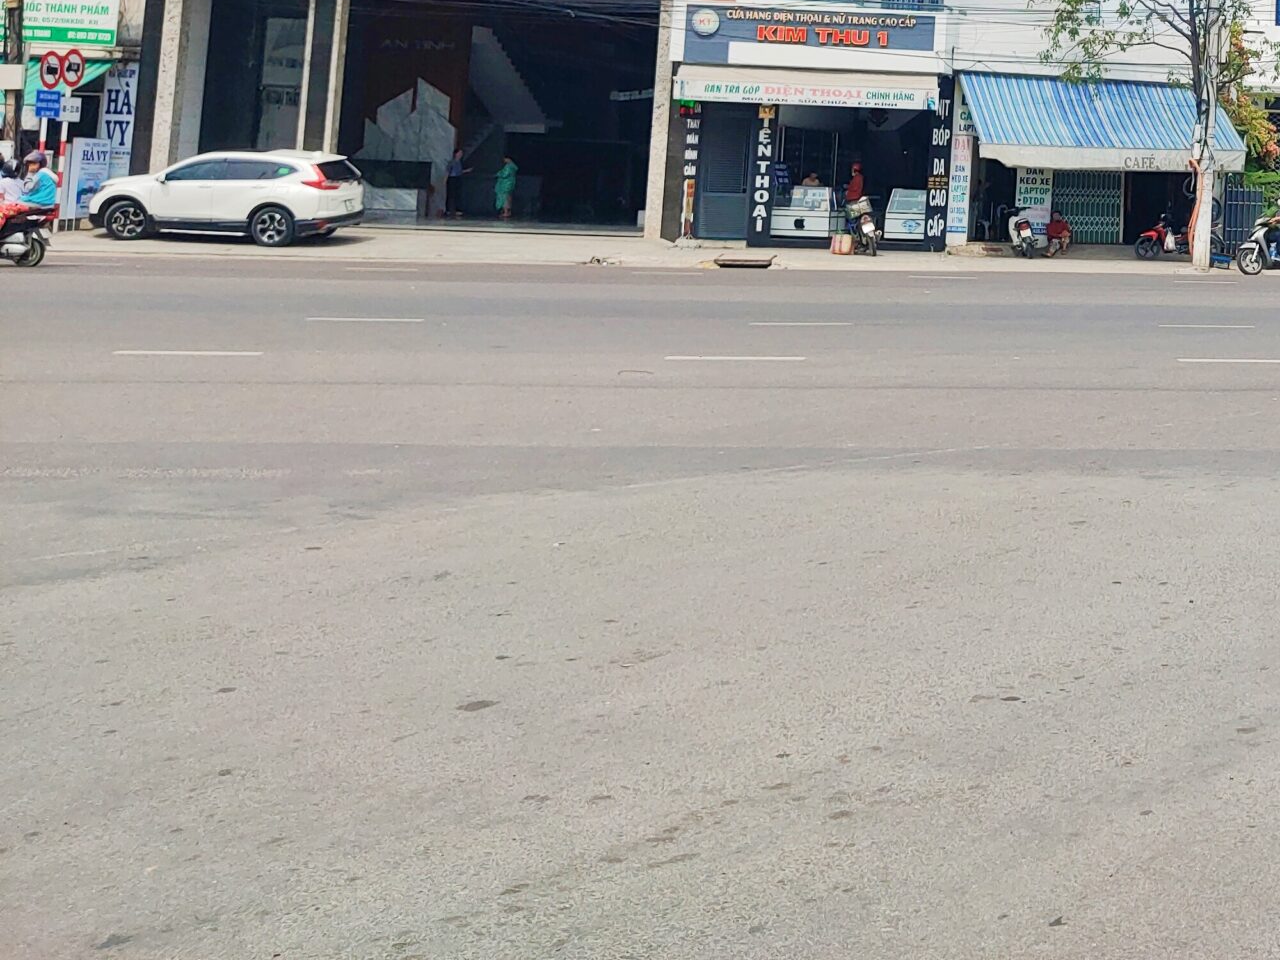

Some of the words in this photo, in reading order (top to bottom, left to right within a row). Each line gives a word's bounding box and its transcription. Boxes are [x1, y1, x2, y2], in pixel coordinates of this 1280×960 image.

[796, 13, 822, 24] THOẠI
[824, 16, 831, 24] &
[848, 16, 877, 26] TRANG
[879, 18, 897, 27] CAO
[757, 25, 807, 43] KIM
[815, 28, 869, 46] THU
[877, 31, 888, 46] 1
[105, 81, 133, 115] HÀ
[687, 118, 700, 129] THAY
[105, 120, 131, 146] VY
[932, 125, 950, 146] BÓP
[97, 151, 108, 161] VY
[1124, 154, 1156, 169] CAFÉ
[933, 158, 945, 175] DA
[1019, 177, 1036, 185] KEO
[929, 189, 946, 207] CAO
[1019, 186, 1050, 196] LAPTOP
[927, 215, 945, 237] CẤP
